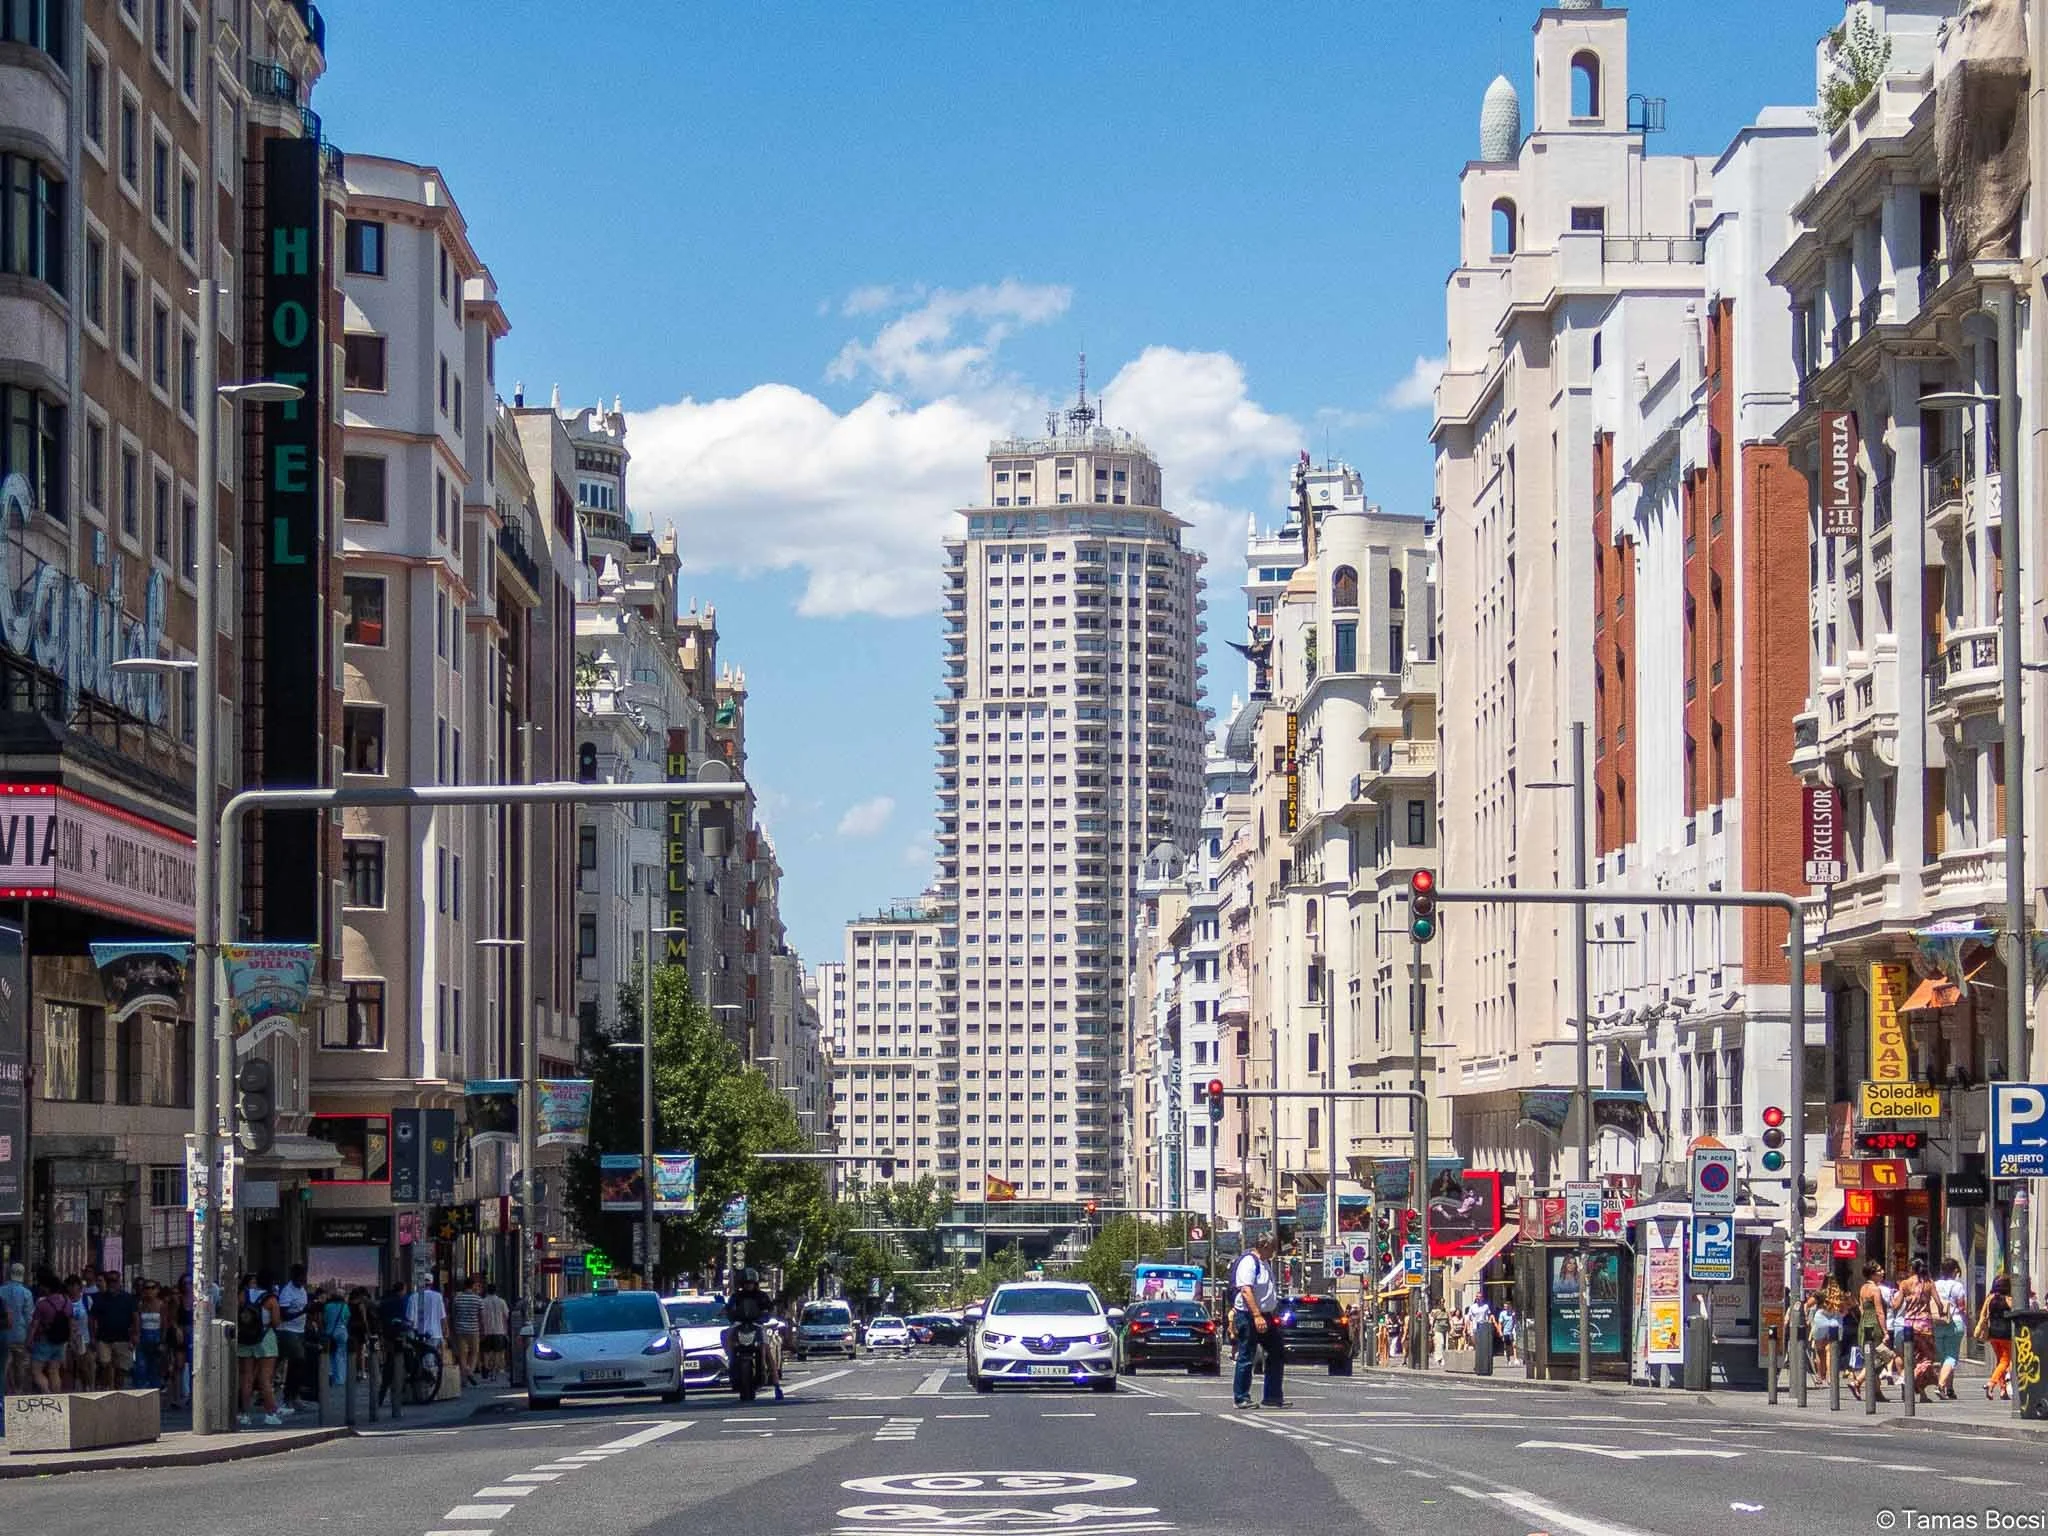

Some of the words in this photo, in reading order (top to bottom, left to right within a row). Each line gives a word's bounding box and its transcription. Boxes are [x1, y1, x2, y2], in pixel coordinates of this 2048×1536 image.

[272, 227, 308, 566] HOTEL
[1832, 415, 1849, 505] LAURIA
[1288, 716, 1297, 759] HOSTAL
[667, 754, 685, 892] HTEL
[1812, 790, 1833, 861] EXCELSIOR
[1867, 1084, 1934, 1099] Soledad
[1870, 1101, 1932, 1116] Cabello
[1999, 1088, 2045, 1144] P
[2000, 1163, 2018, 1174] 24
[2001, 1154, 2044, 1163] ABIERTO
